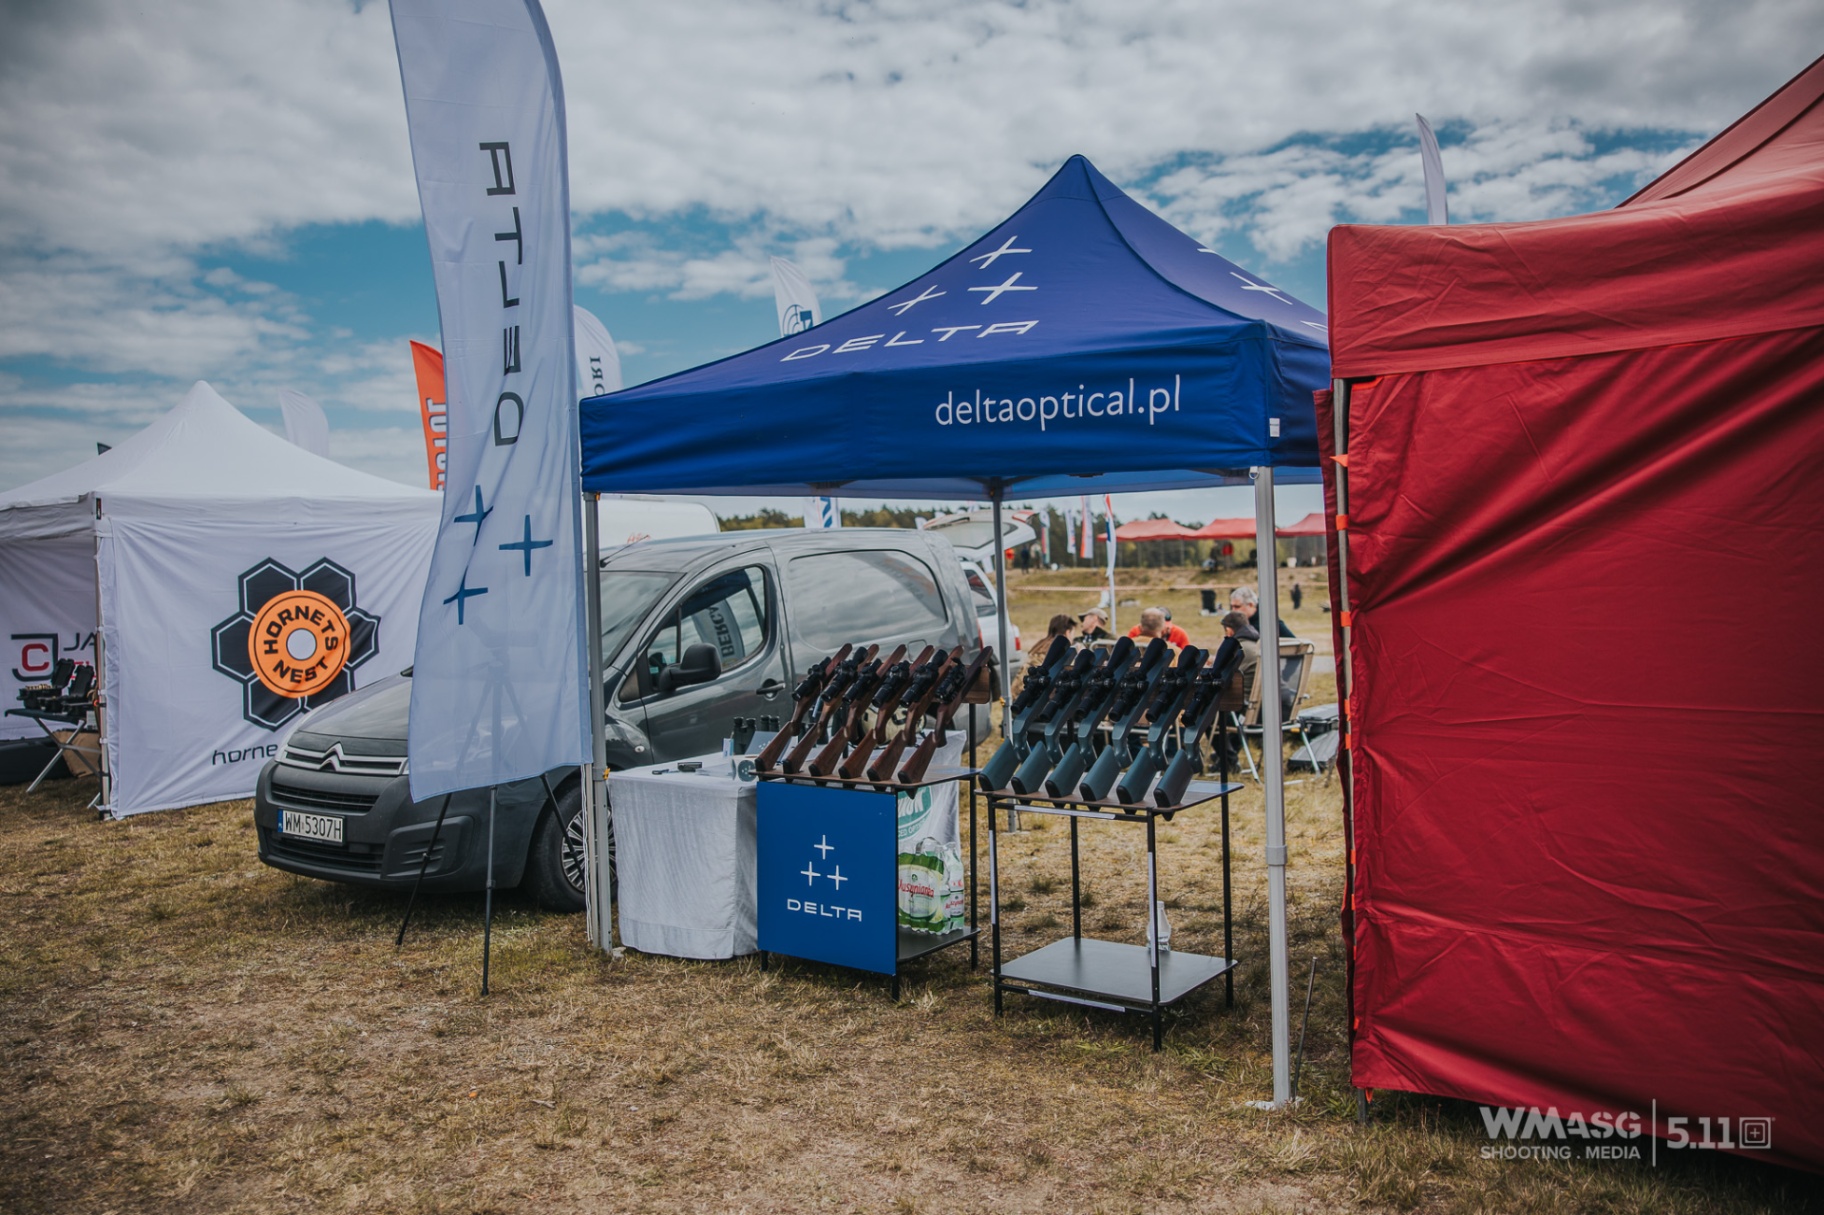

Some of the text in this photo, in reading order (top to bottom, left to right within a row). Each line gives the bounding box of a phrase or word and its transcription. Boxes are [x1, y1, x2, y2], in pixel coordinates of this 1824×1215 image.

[779, 320, 1040, 362] DELTA
[935, 373, 1181, 432] deltaoptical.pl
[263, 605, 339, 655] HORNETS
[272, 655, 328, 684] NEST
[212, 744, 279, 766] horne
[285, 812, 342, 840] WM 5307H
[787, 898, 862, 922] DELTA
